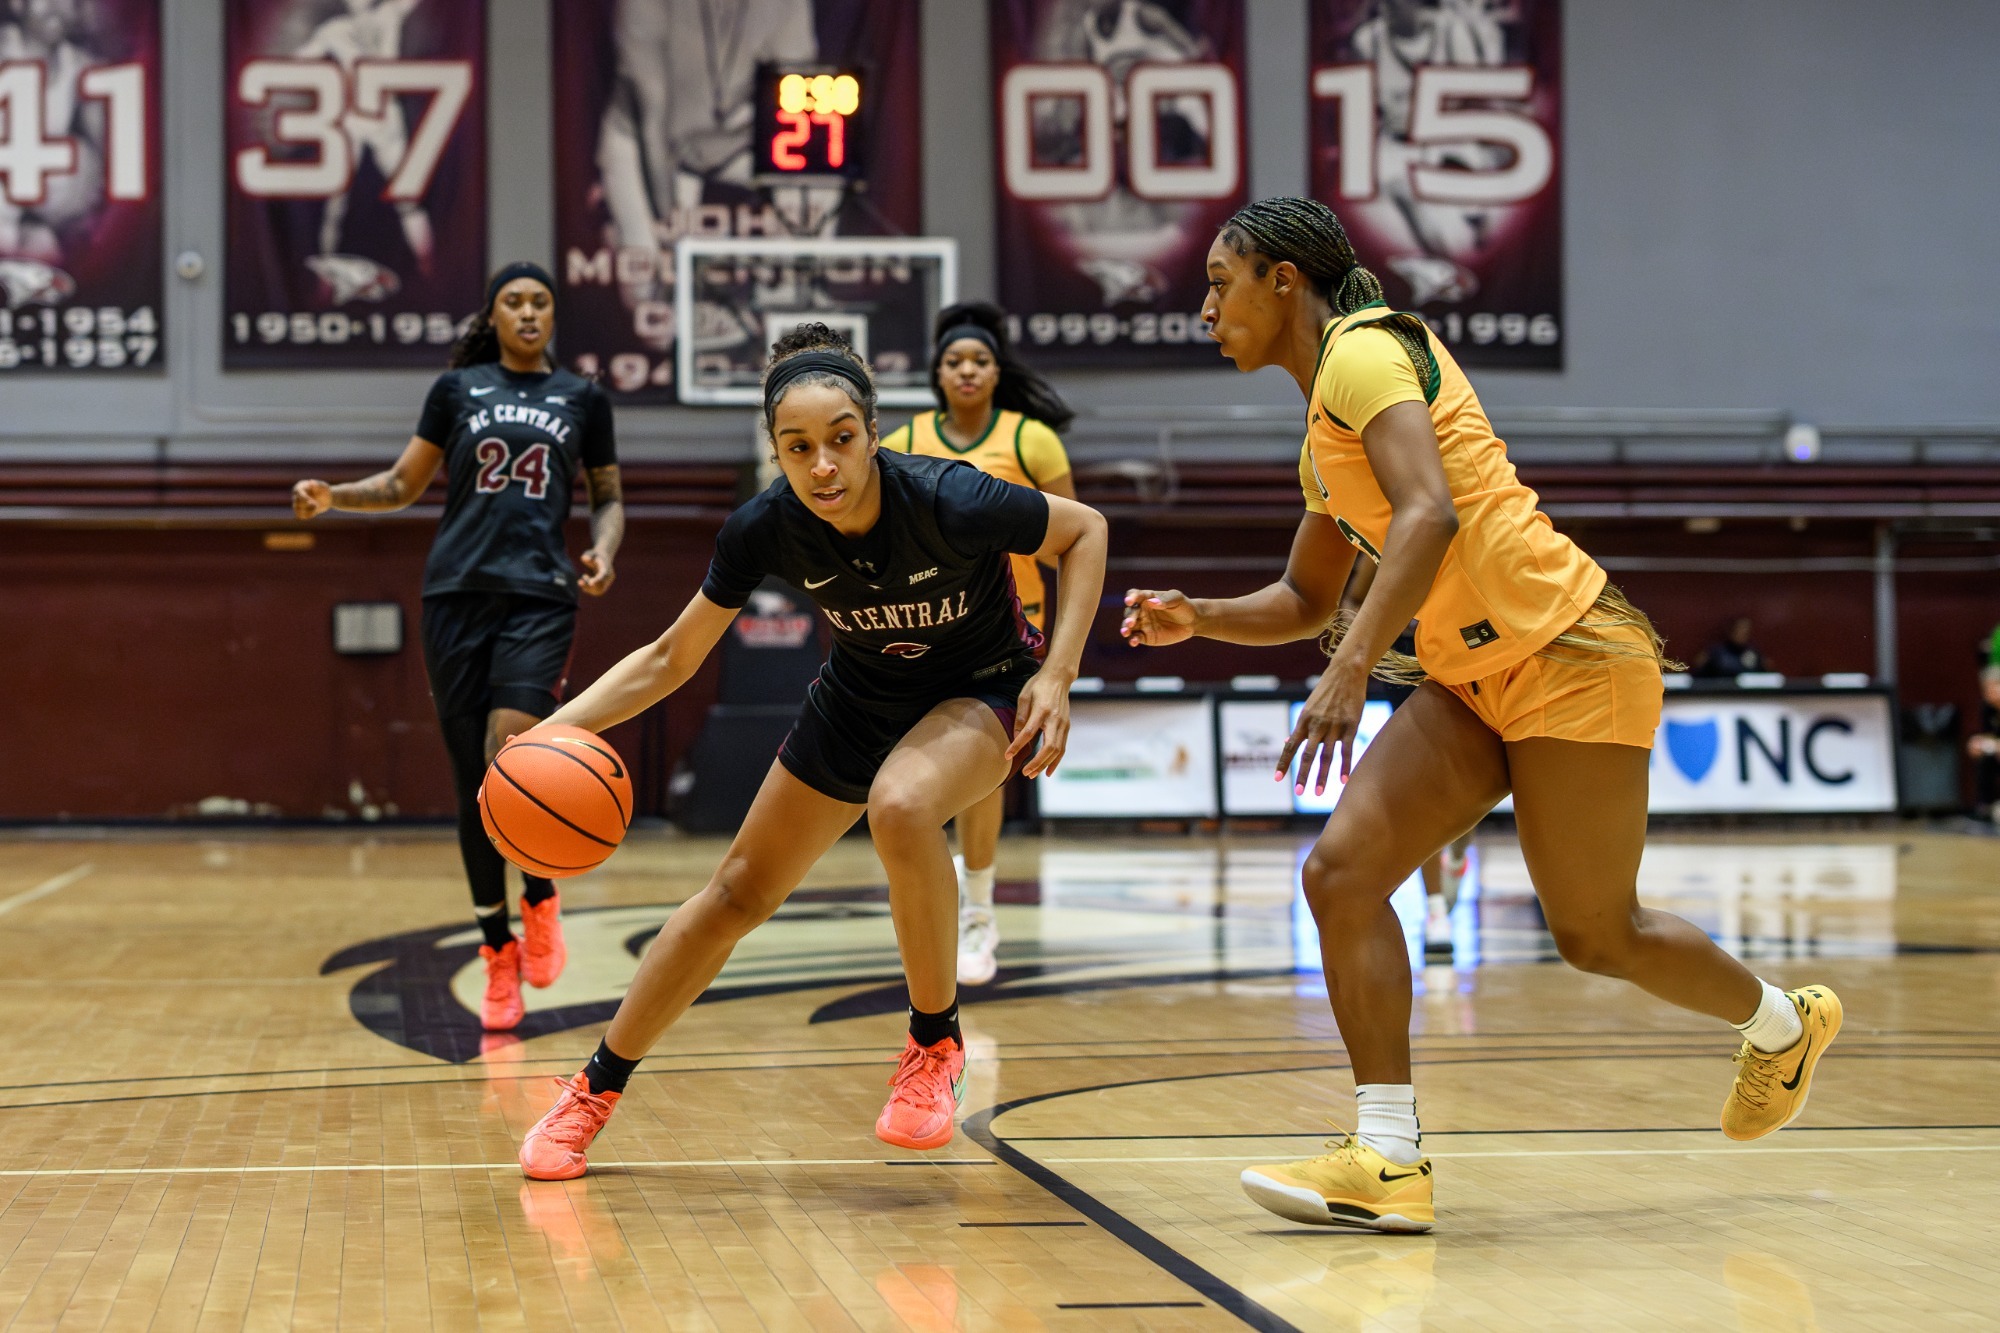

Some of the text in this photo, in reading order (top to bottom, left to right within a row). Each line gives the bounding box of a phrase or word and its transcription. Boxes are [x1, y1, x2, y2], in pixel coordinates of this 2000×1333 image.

[237, 60, 473, 200] 37
[772, 109, 844, 170] 27
[1002, 64, 1239, 200] 00
[1311, 63, 1554, 202] 15
[1006, 312, 1214, 345] 1999-200
[468, 404, 571, 444] NC CENTRAL
[475, 437, 551, 499] 24
[909, 567, 938, 585] MEAC
[851, 590, 969, 632] CENTRAL
[1735, 716, 1854, 785] NC
